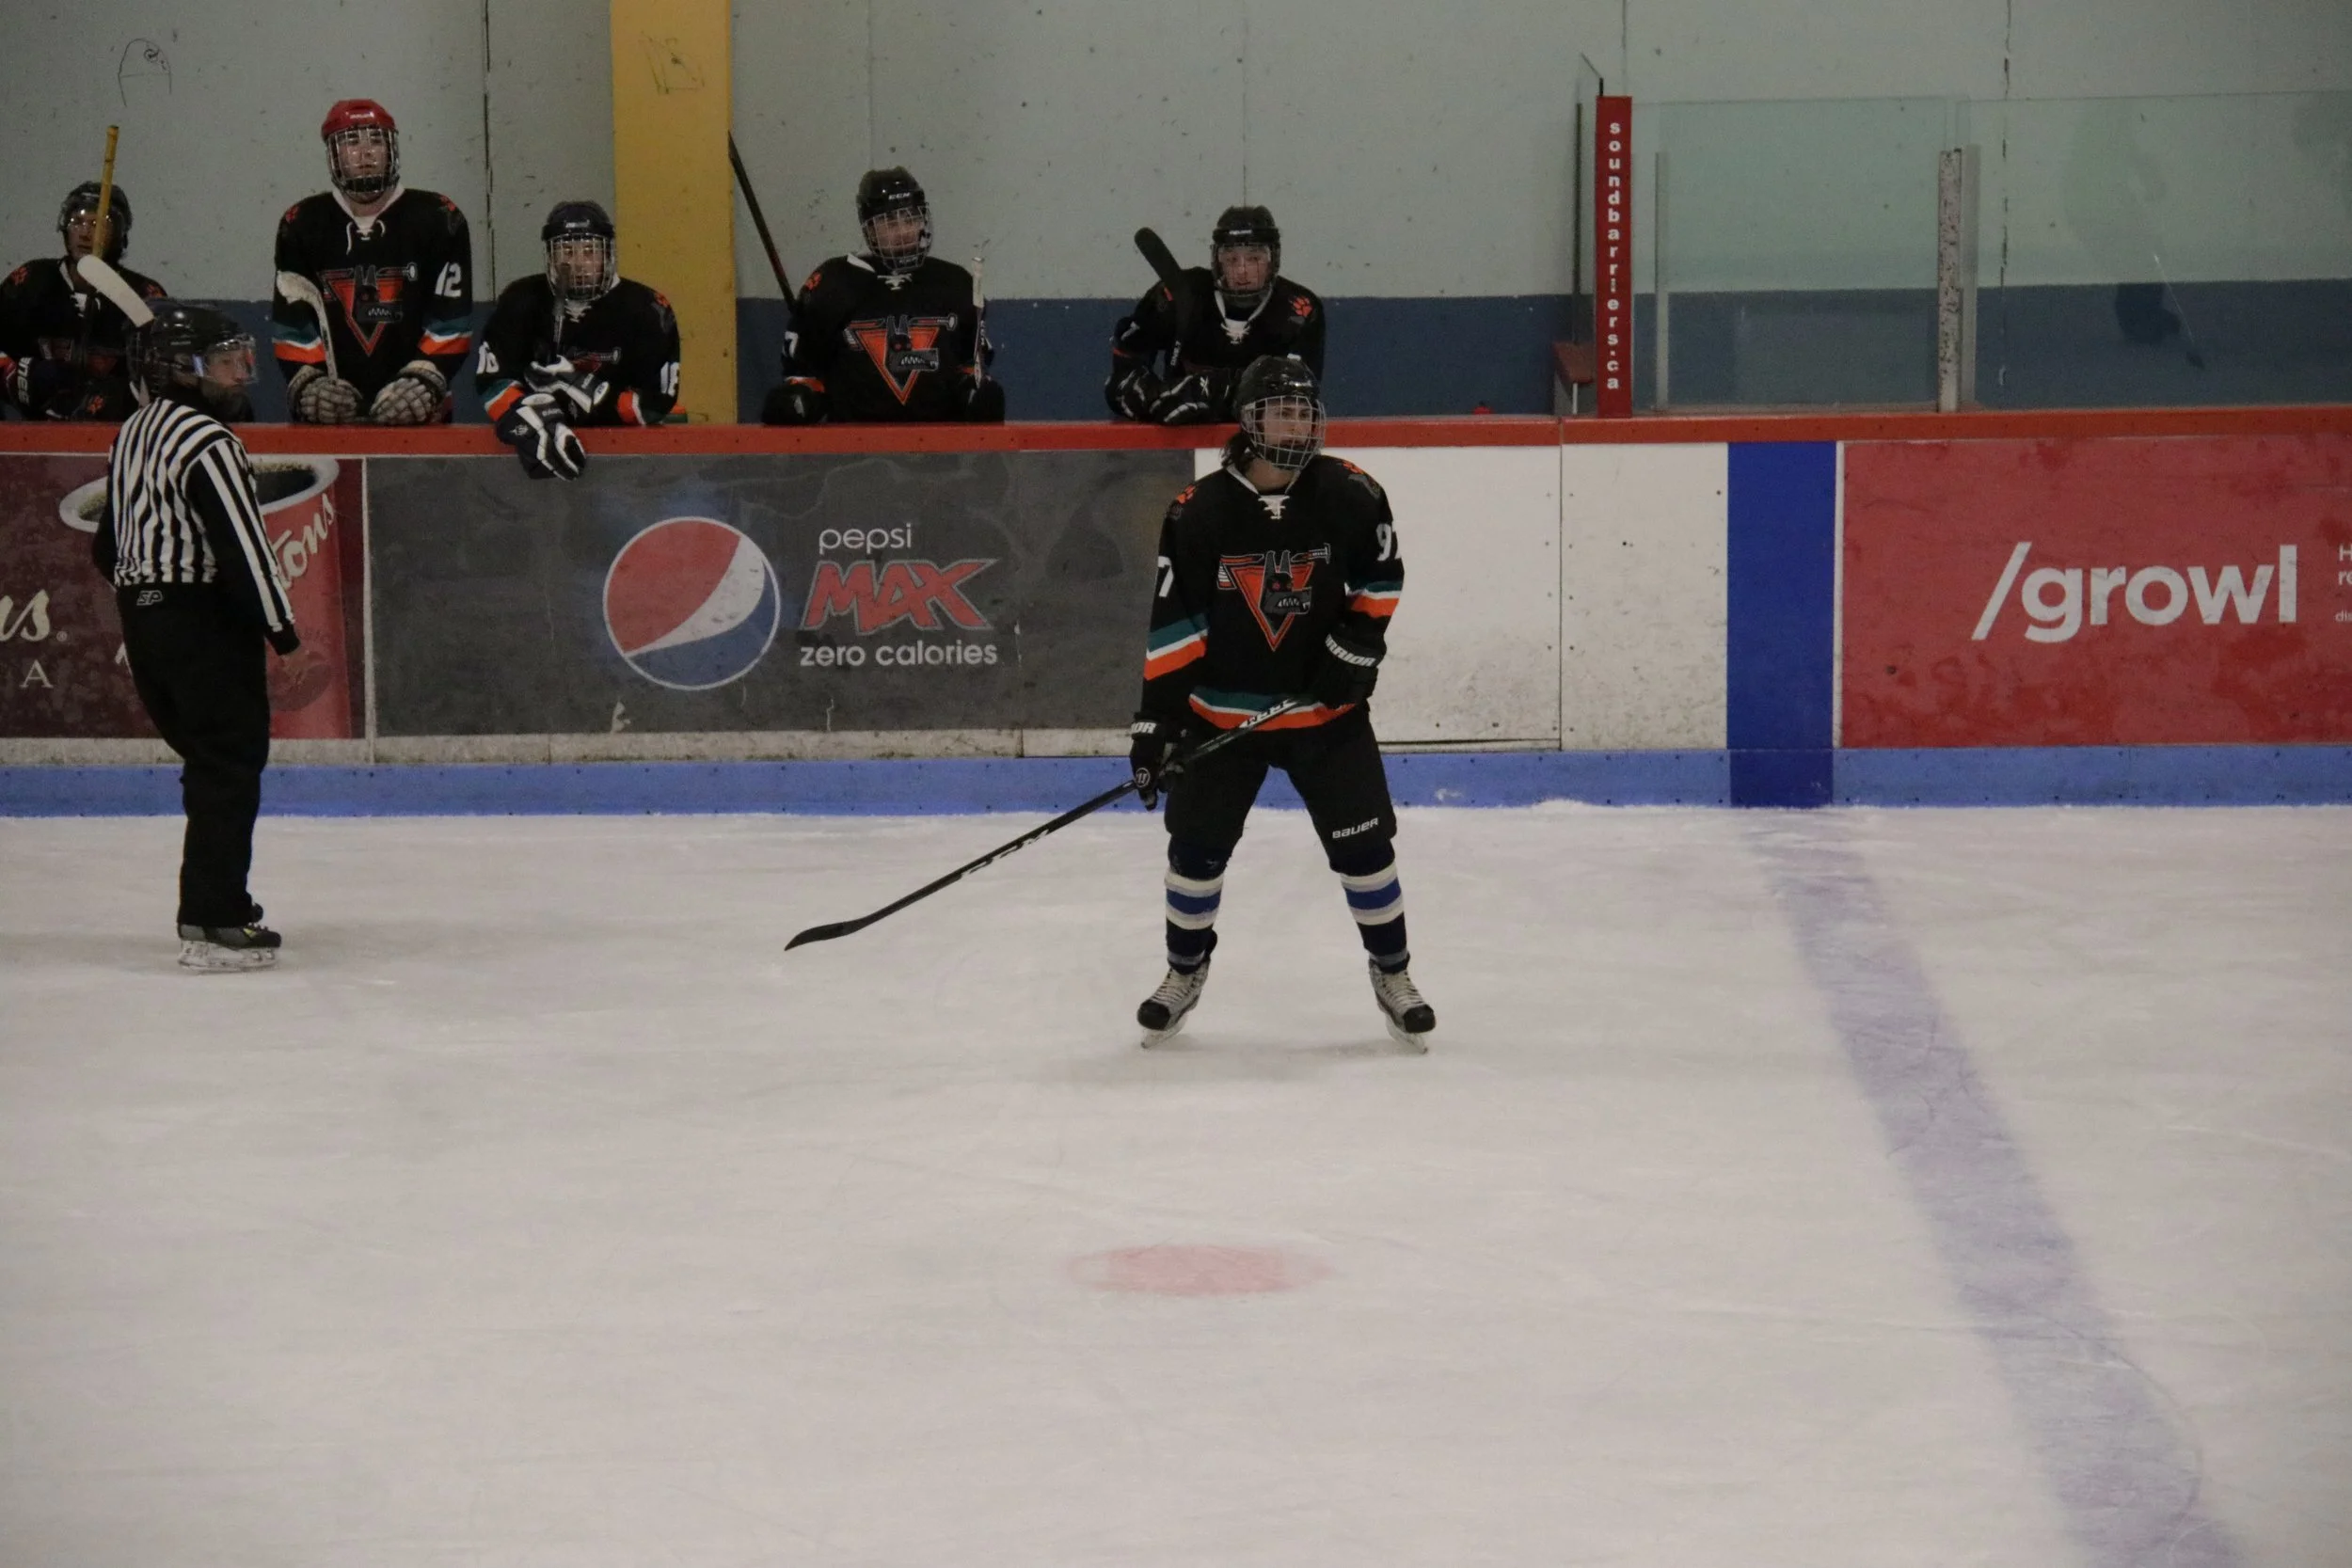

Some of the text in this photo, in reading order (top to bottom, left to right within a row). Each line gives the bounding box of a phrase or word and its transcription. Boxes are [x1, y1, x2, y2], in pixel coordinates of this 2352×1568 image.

[1607, 121, 1621, 390] soundbarriers.ca
[435, 261, 462, 298] 12
[475, 341, 500, 374] 16
[818, 522, 913, 555] pepsi
[799, 558, 999, 636] MAX
[800, 639, 998, 667] zero calories
